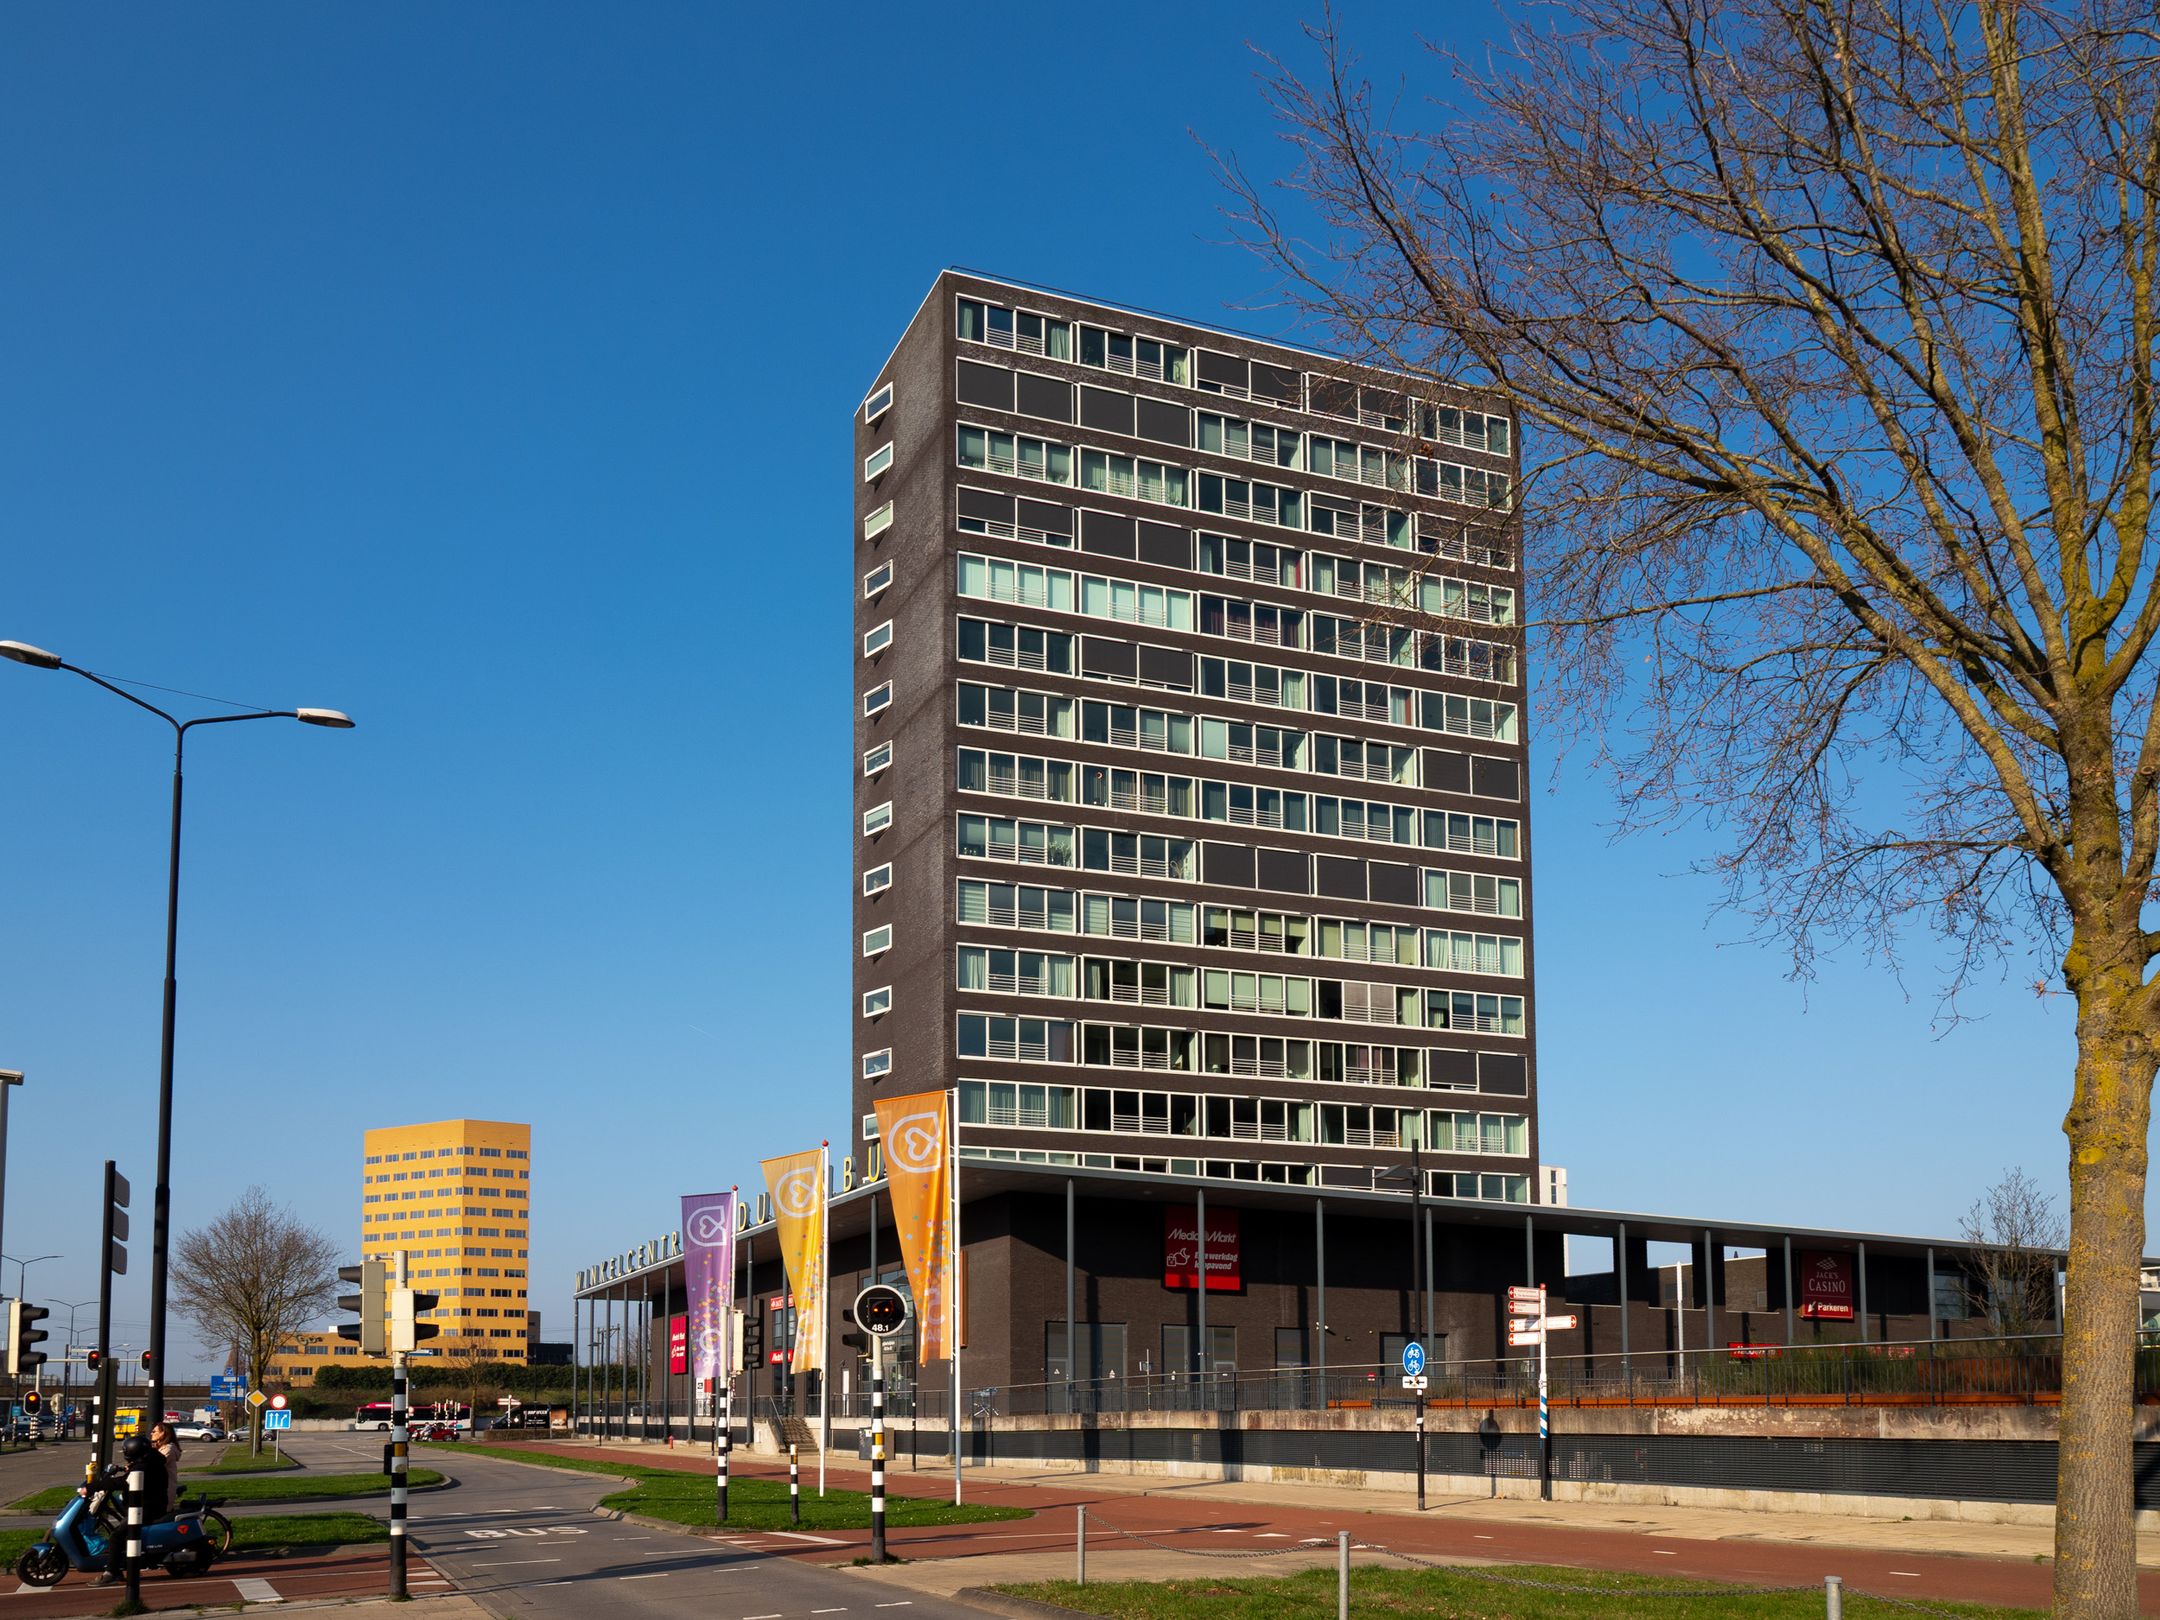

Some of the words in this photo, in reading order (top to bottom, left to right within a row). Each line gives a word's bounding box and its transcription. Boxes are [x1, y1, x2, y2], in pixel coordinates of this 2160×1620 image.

[1808, 1278, 1846, 1293] CASINO
[1817, 1302, 1849, 1312] Parkeren
[871, 1323, 889, 1332] 48.1
[463, 1526, 589, 1538] BUS
